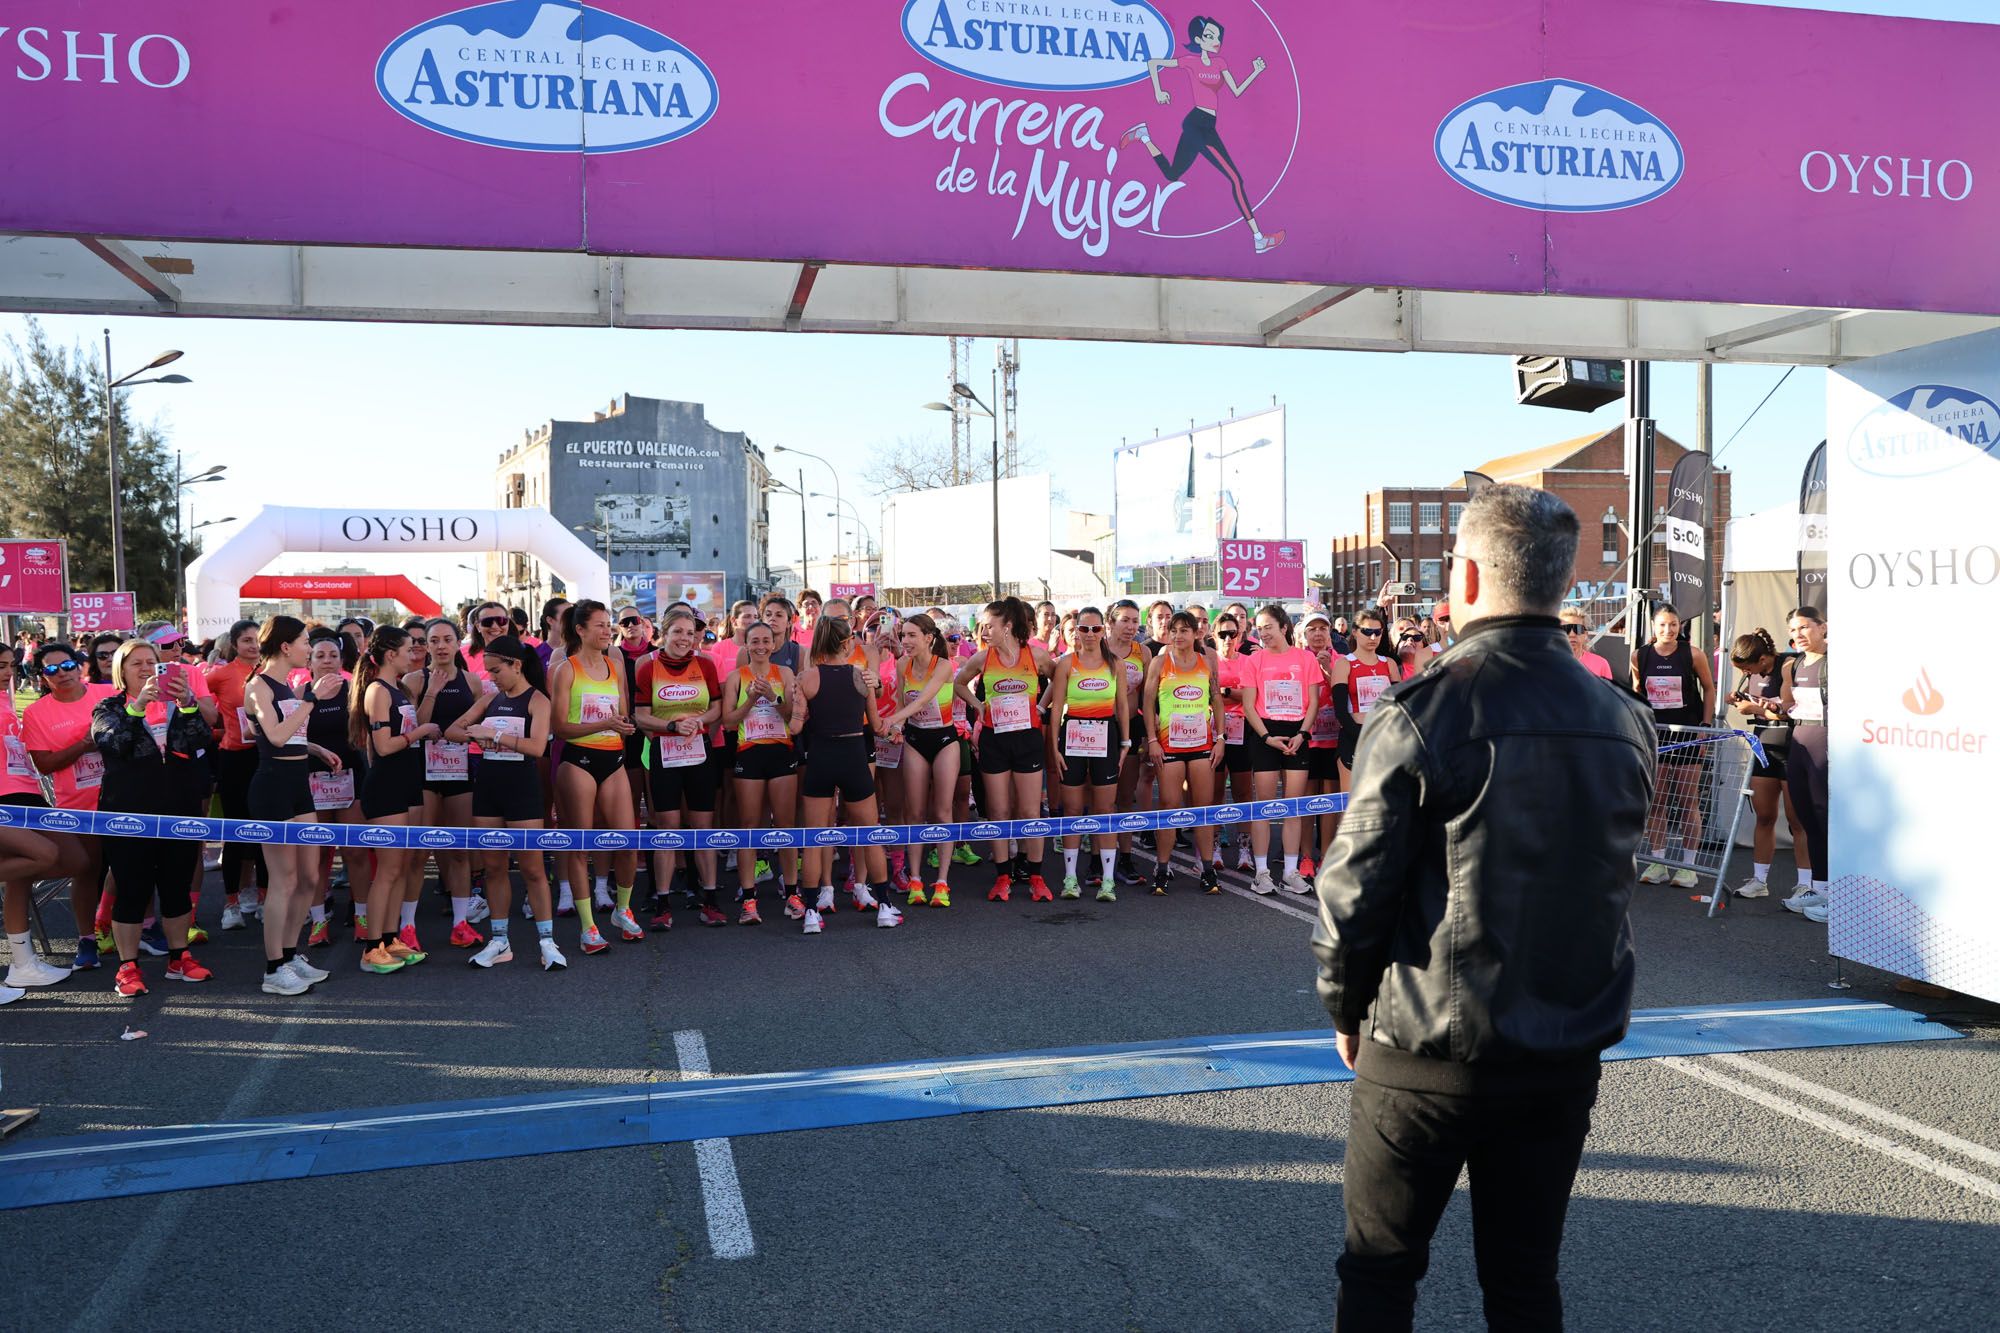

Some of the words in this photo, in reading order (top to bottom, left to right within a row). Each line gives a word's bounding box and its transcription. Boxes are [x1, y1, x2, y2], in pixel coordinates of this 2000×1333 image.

[966, 0, 1051, 17] CENTRAL
[1061, 7, 1145, 25] LECHERA
[923, 0, 1151, 62] ASTURIANA
[0, 27, 191, 88] SHO
[458, 47, 565, 65] CENTRAL
[576, 53, 682, 74] LECHERA
[404, 48, 694, 118] ASTURIANA
[878, 72, 1104, 151] Carrera
[1494, 121, 1572, 137] CENTRAL
[1580, 127, 1658, 144] LECHERA
[1455, 121, 1666, 182] ASTURIANA
[1800, 150, 1974, 201] OYSHO
[935, 151, 977, 193] de
[987, 148, 1018, 197] la
[1011, 147, 1187, 257] Mujer
[1930, 407, 1986, 423] LECHERA
[566, 442, 581, 454] EL
[584, 440, 633, 456] PUERTO
[637, 440, 720, 458] VALENCIA.com
[579, 459, 651, 469] Restaurante
[1673, 487, 1704, 505] OYSHO
[341, 515, 478, 542] OYSHO
[1226, 543, 1266, 560] SUB
[22, 567, 61, 576] OYSHO
[1276, 561, 1303, 569] OYSHO
[1848, 545, 2000, 589] OYSHO
[279, 580, 303, 589] Sports
[313, 581, 352, 589] Santander
[621, 575, 655, 592] Mar
[1225, 567, 1269, 591] 25'
[1674, 571, 1703, 588] OYSHO
[836, 586, 857, 596] SUB
[73, 597, 104, 608] SUB
[73, 612, 107, 629] 35'
[659, 689, 697, 698] Serrano
[758, 723, 775, 731] 016
[1862, 719, 1988, 754] Santander
[442, 757, 460, 765] 016
[43, 817, 78, 827] ASTURIANA
[108, 822, 142, 832] ASTURIANA
[173, 826, 208, 834] ASTURIANA
[238, 829, 272, 838] ASTURIANA
[301, 831, 333, 840] ASTURIANA
[361, 834, 394, 842] ASTURIANA
[422, 835, 453, 844] ASTURIANA
[481, 836, 513, 844] ASTURIANA
